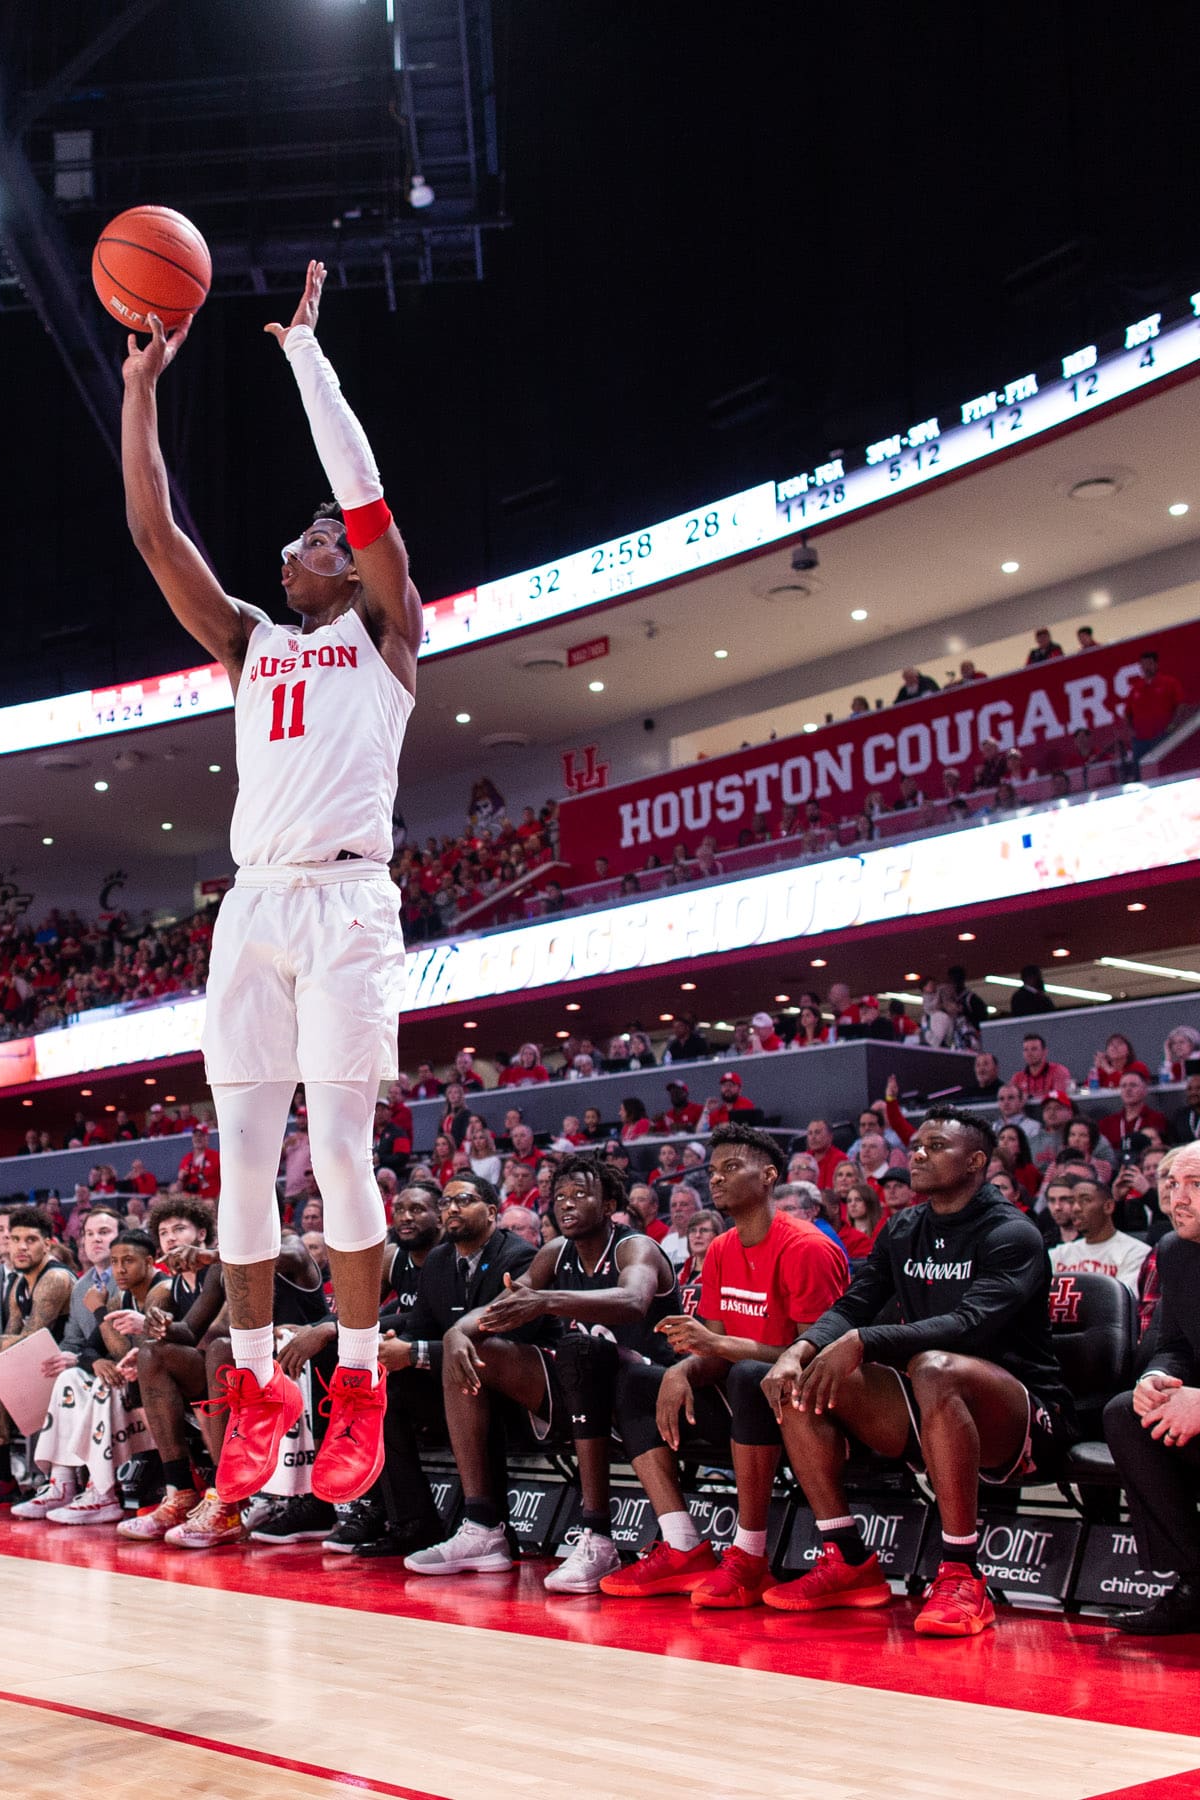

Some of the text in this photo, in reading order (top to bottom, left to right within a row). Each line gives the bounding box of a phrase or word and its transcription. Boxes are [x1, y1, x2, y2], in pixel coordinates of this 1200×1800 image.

[1139, 345, 1155, 369] 4
[1068, 372, 1098, 402] 12
[528, 568, 560, 600] 32
[590, 533, 653, 575] 2:58
[684, 511, 720, 545] 28
[96, 709, 115, 725] 14
[122, 703, 144, 721] 24
[173, 694, 183, 709] 4
[269, 680, 306, 742] 11
[618, 742, 854, 849] HOUSTON
